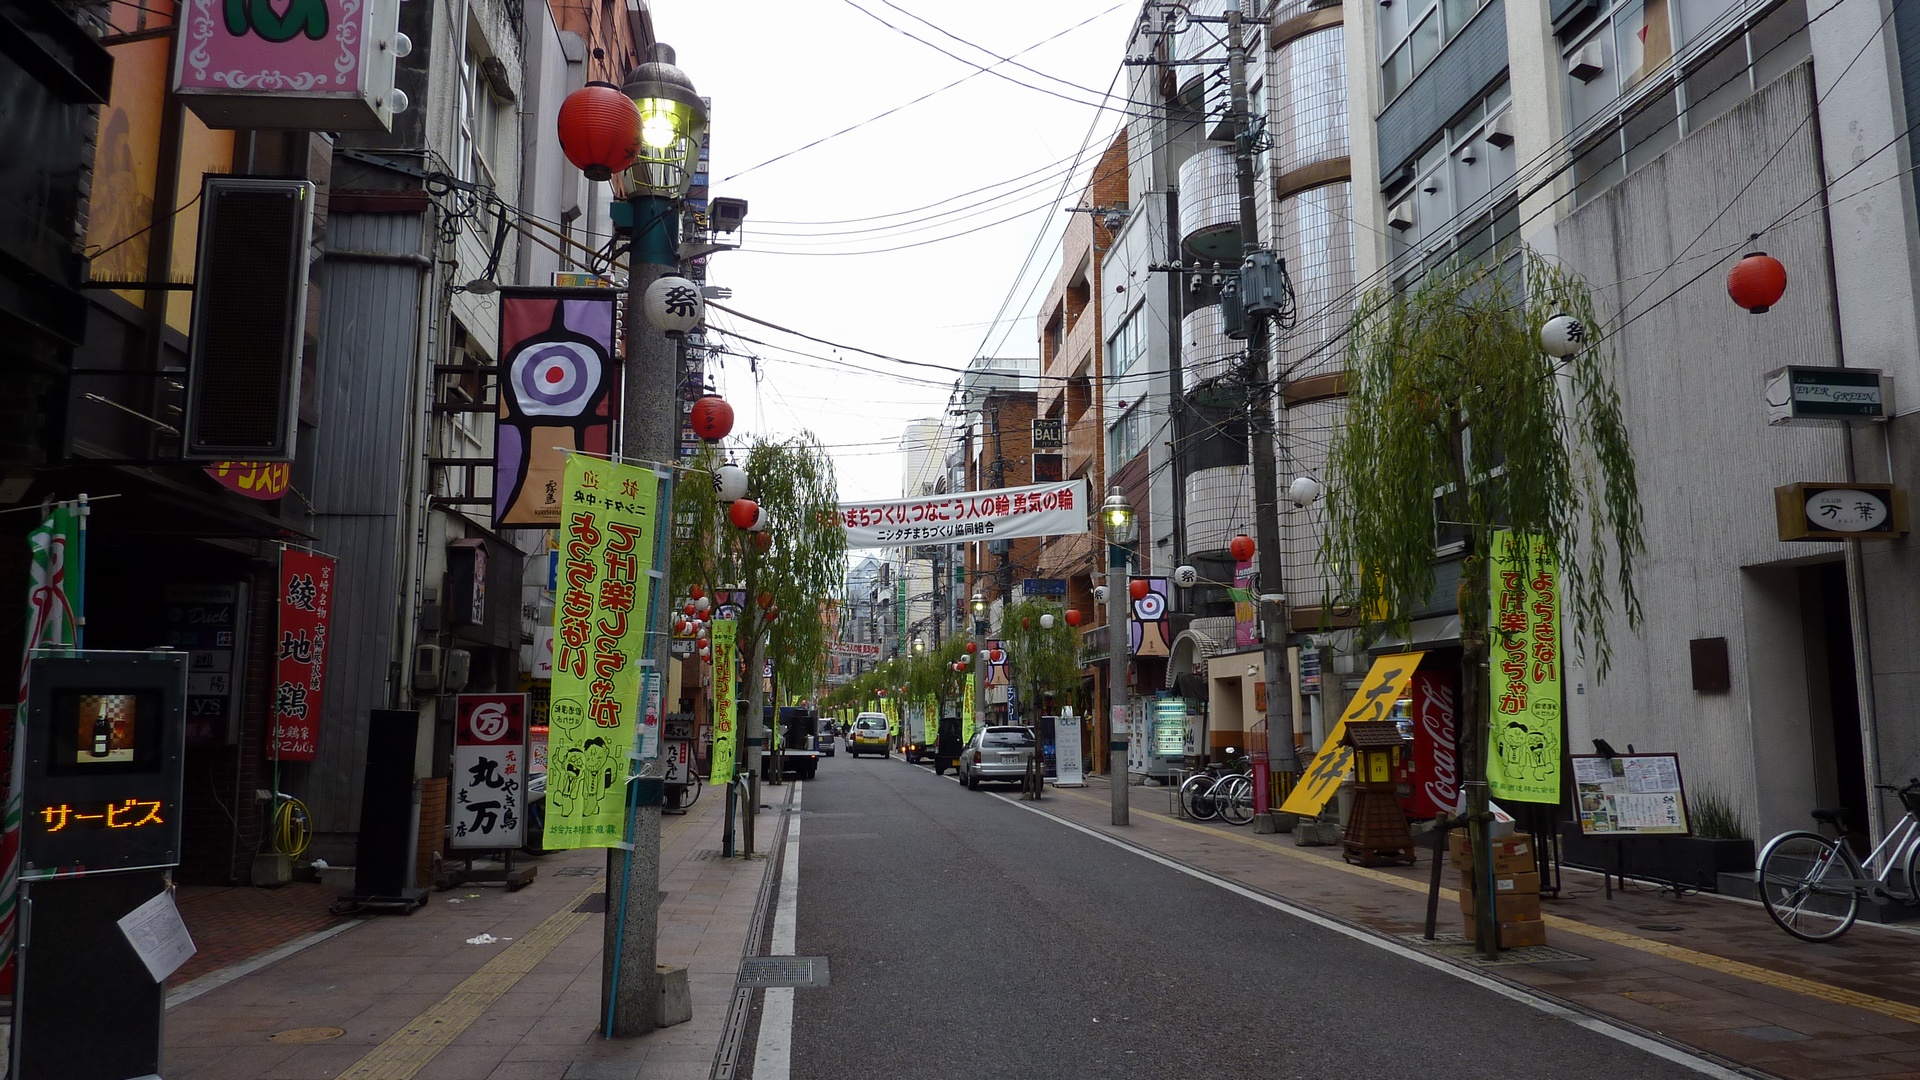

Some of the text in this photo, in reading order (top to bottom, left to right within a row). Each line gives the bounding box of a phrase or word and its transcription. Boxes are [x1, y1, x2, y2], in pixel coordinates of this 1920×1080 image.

[666, 286, 698, 317] 祭
[1566, 320, 1583, 343] 祭
[1796, 386, 1876, 402] EVER GREEN
[1035, 428, 1061, 441] BALI
[1013, 488, 1073, 516] 勇気の輪
[1820, 502, 1876, 522] 万葉
[1531, 571, 1555, 684] よっちきない
[276, 574, 317, 720] 綾地鶏
[505, 750, 518, 775] 元祖
[466, 757, 505, 835] 丸万
[40, 799, 163, 832] サービス
